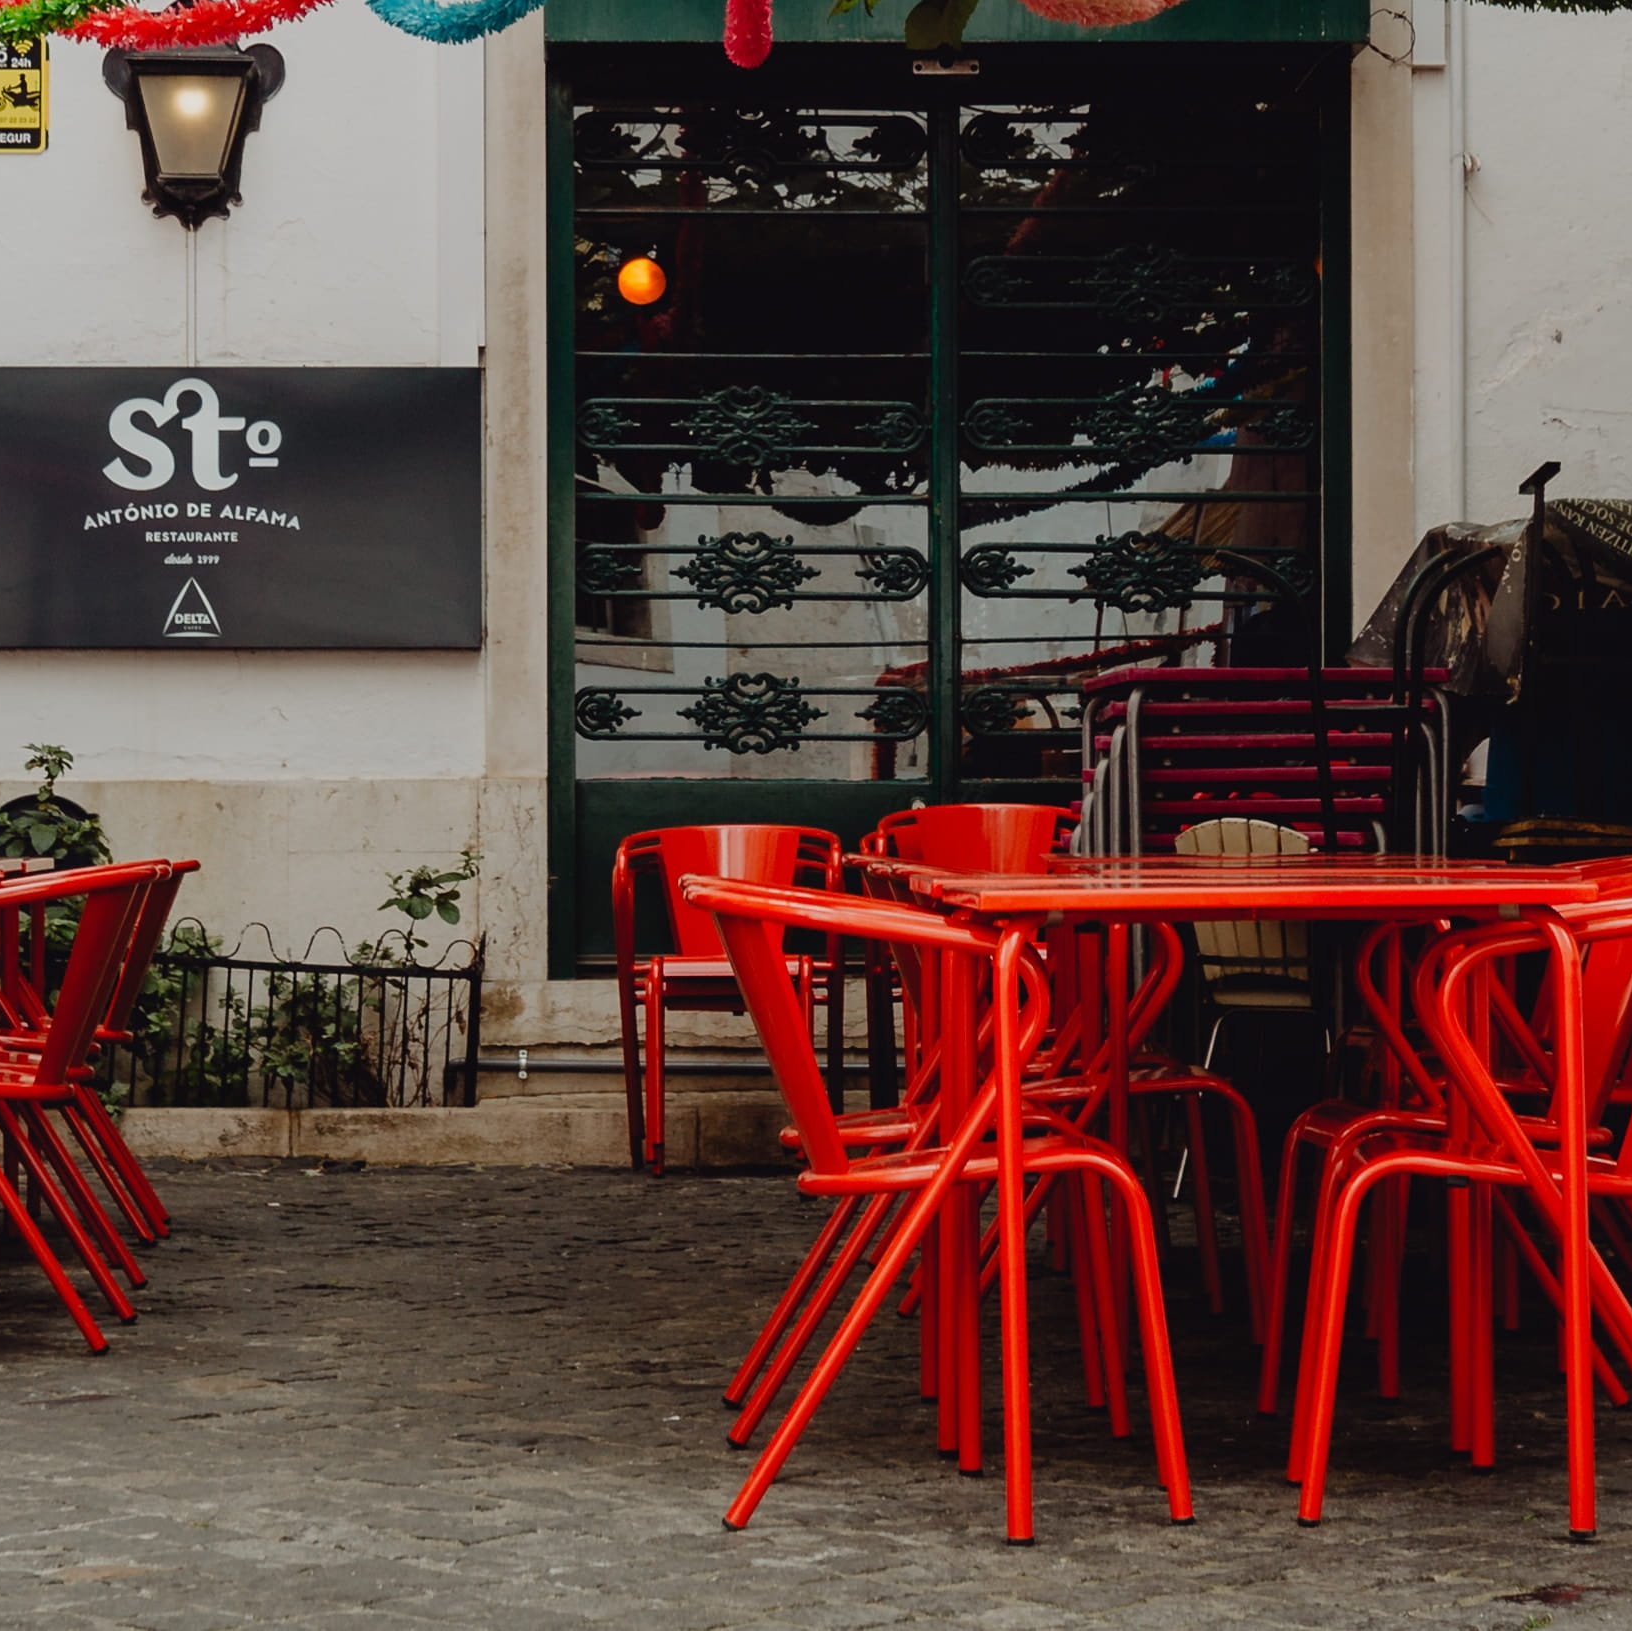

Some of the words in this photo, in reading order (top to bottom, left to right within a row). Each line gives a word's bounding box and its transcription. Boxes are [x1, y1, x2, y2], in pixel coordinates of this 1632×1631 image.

[11, 57, 31, 68] 24h
[83, 502, 179, 530] ANTÓNIO
[186, 503, 212, 518] DE
[219, 504, 301, 530] ALFAMA
[145, 531, 239, 543] RESTAURANTE
[164, 553, 193, 565] desde
[197, 555, 220, 565] 1999
[174, 613, 211, 624] DELTA
